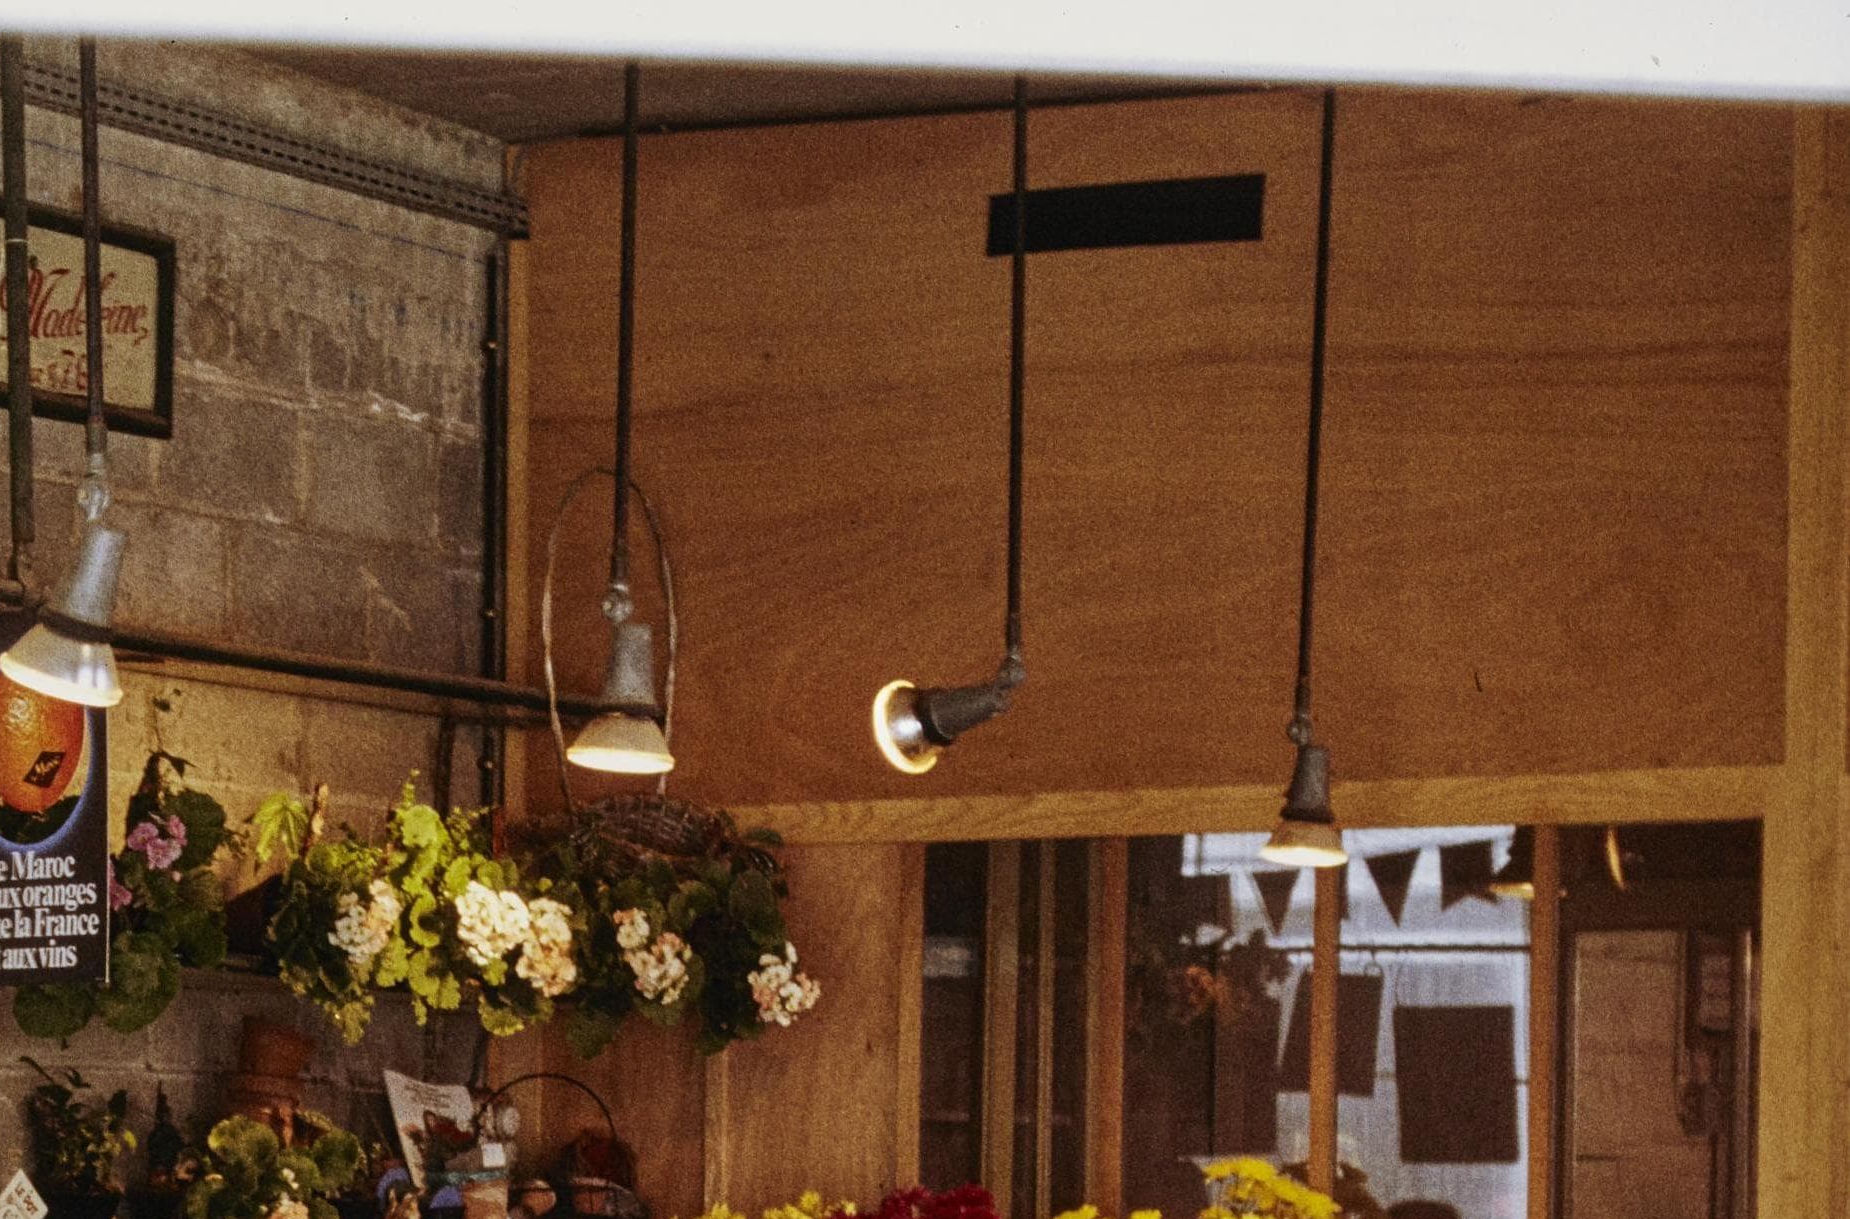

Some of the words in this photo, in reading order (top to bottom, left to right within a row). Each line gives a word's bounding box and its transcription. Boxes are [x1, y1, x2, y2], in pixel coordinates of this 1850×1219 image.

[11, 850, 75, 880] Maroc
[22, 883, 97, 911] oranges
[14, 909, 30, 938] la
[34, 908, 100, 937] France
[2, 948, 38, 969] aux
[39, 939, 78, 969] vins
